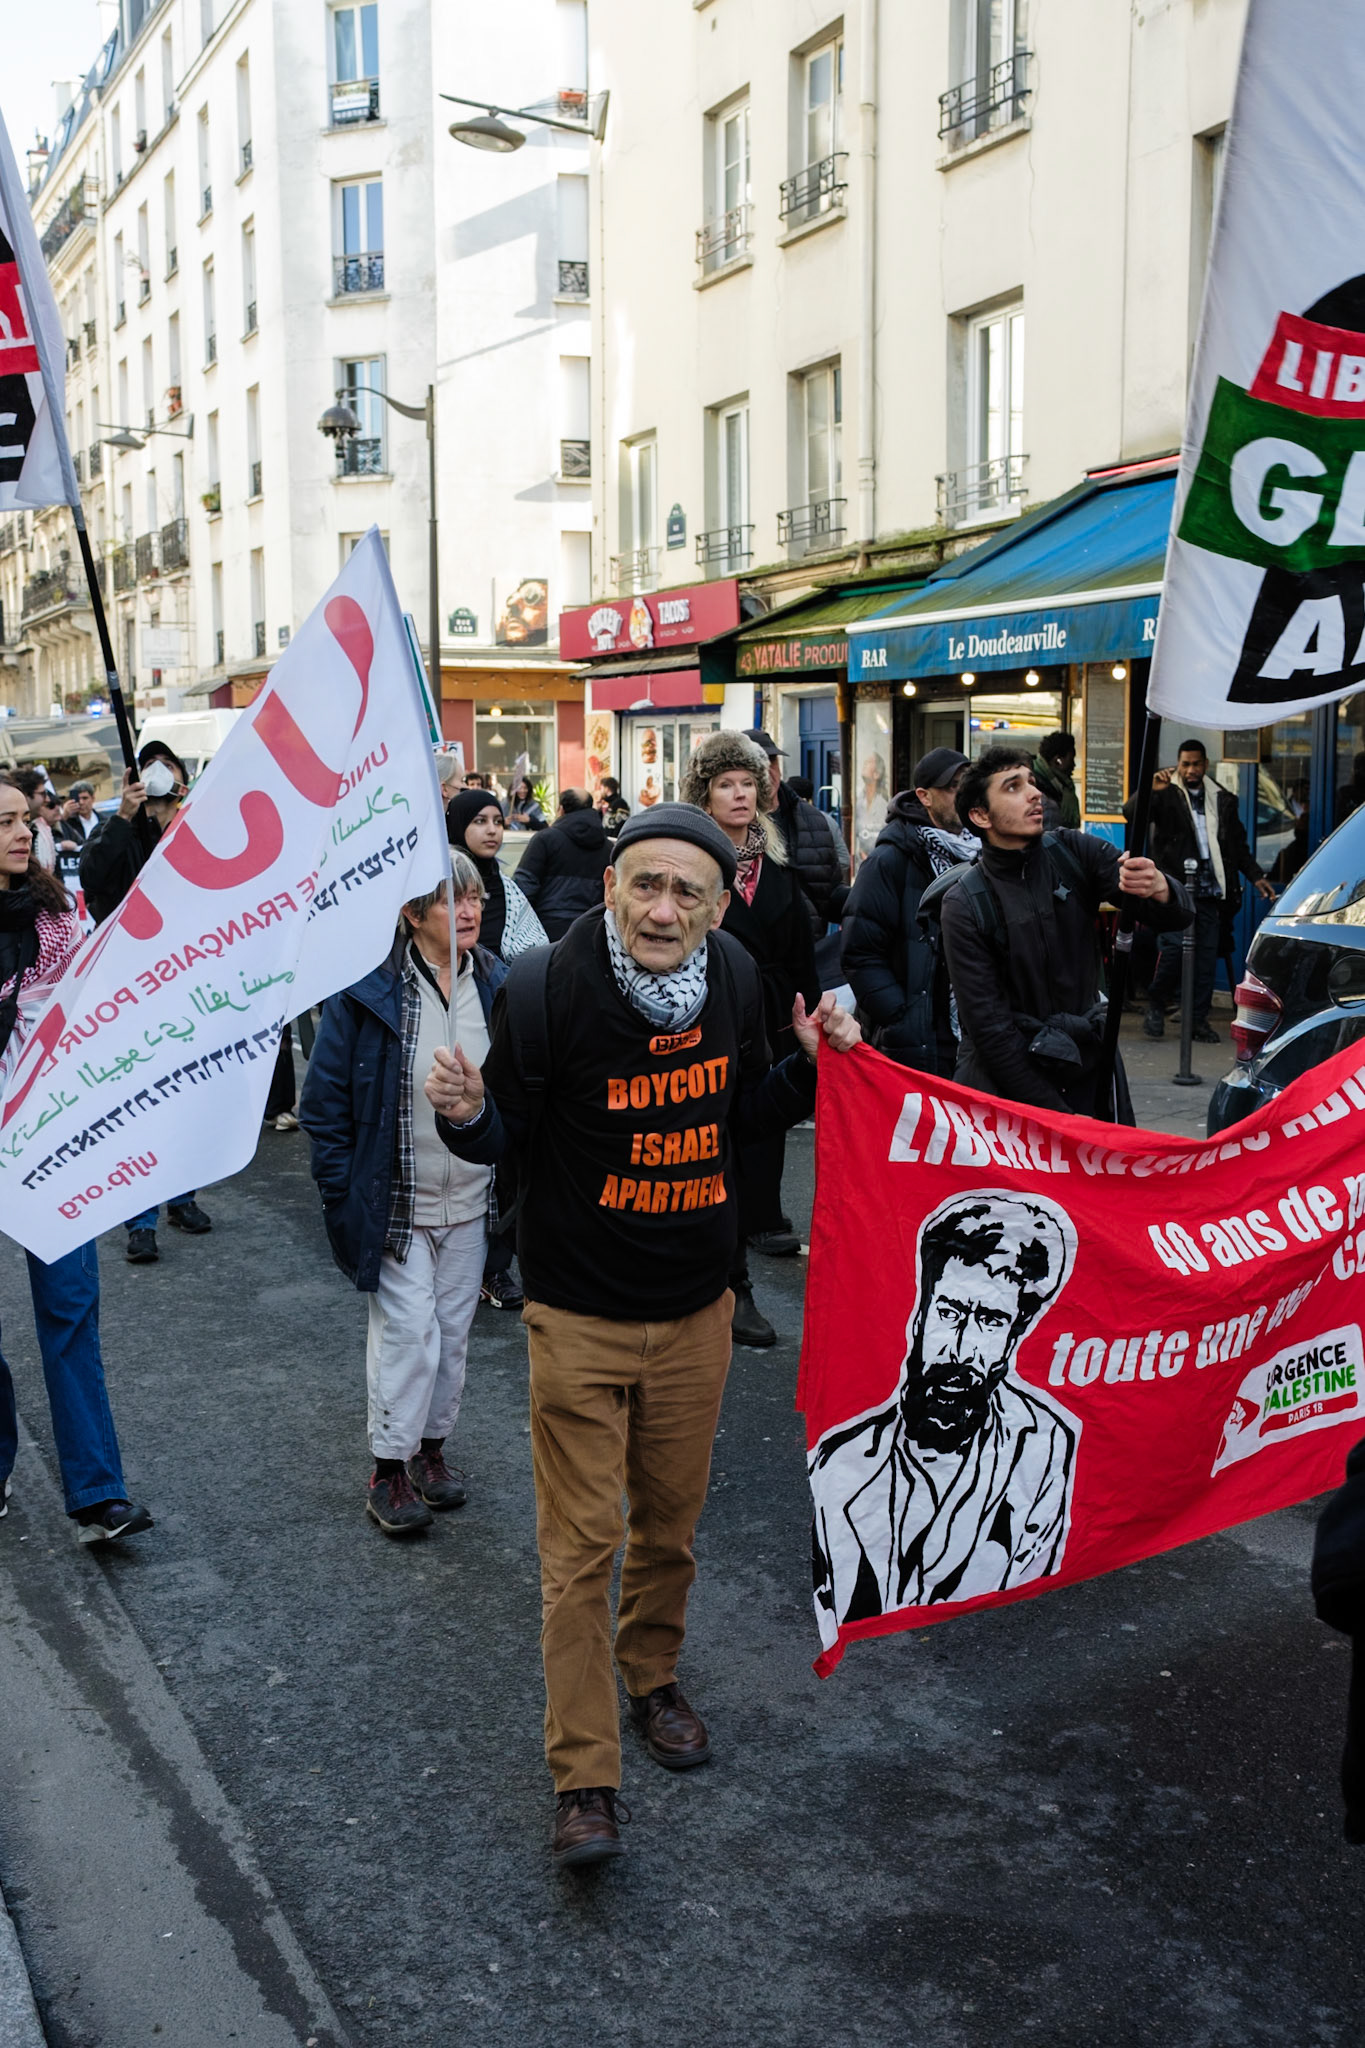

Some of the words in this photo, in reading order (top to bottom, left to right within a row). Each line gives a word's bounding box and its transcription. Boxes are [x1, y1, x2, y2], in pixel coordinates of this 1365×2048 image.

[657, 599, 690, 625] TACOS
[1256, 583, 1365, 680] A
[740, 651, 751, 671] 43
[754, 641, 802, 670] YATALIE
[804, 642, 849, 665] PRODUI
[860, 648, 888, 669] BAR
[948, 637, 965, 661] Le
[967, 622, 1067, 659] Doudeauville
[607, 1056, 729, 1110] BOYCOTT
[630, 1123, 719, 1166] ISRAEL
[598, 1170, 728, 1214] APARTHEID
[1147, 1221, 1211, 1276] 40
[1202, 1208, 1289, 1269] ans
[1278, 1183, 1339, 1243] de
[1342, 1175, 1365, 1232] p
[1047, 1329, 1190, 1387] toute
[1195, 1305, 1268, 1370] une
[1266, 1341, 1347, 1393] URGENCE
[1261, 1363, 1357, 1419] PALESTINE
[1288, 1405, 1311, 1424] PARIS
[1312, 1402, 1324, 1414] 18
